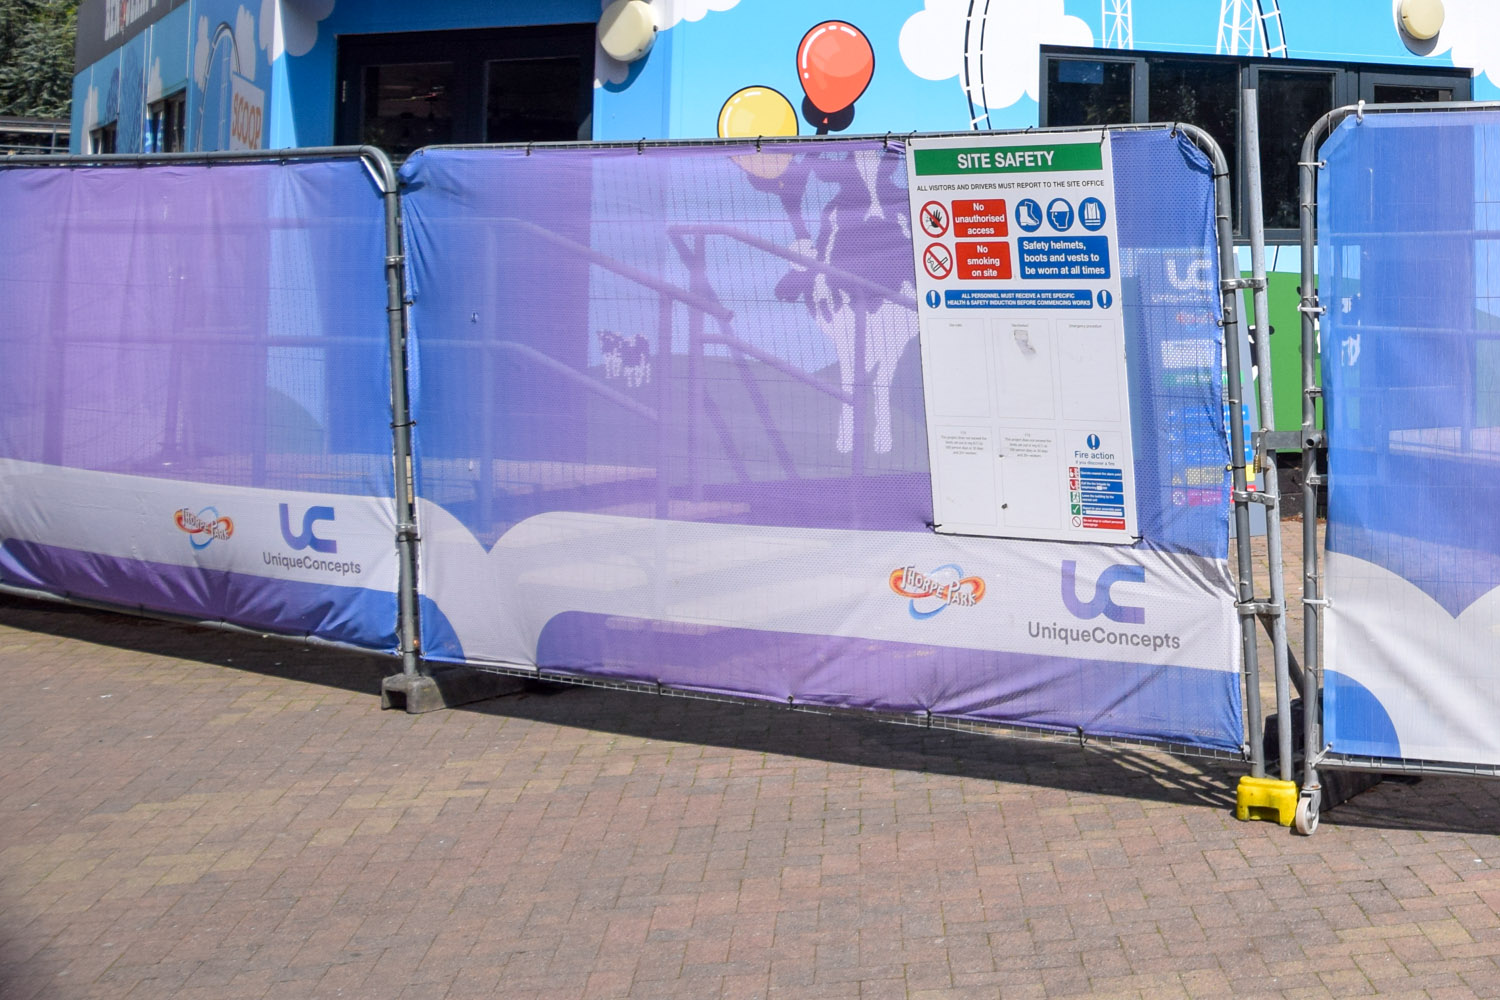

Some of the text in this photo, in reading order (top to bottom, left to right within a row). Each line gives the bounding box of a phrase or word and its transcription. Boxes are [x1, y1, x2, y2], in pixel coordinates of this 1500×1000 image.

[231, 92, 262, 150] SCOOP
[957, 150, 1055, 169] SITE SAFETY
[1016, 181, 1042, 189] REPORT
[1053, 180, 1066, 188] THE
[1081, 179, 1105, 187] OFFICE
[973, 203, 985, 211] No
[955, 214, 1005, 223] unauthorised
[976, 245, 988, 253] No
[1022, 240, 1087, 251] Safety helmets,
[967, 257, 1000, 266] smoking
[1024, 253, 1100, 262] boots and vests to
[983, 268, 998, 277] site
[1025, 266, 1036, 275] be
[1060, 266, 1069, 274] at
[1070, 266, 1080, 274] all
[1082, 266, 1105, 274] times
[1074, 450, 1115, 460] Fire action
[263, 551, 361, 576] UniqueConcepts
[900, 565, 977, 607] THORPE PARK
[1028, 620, 1181, 651] UniqueConcepts
